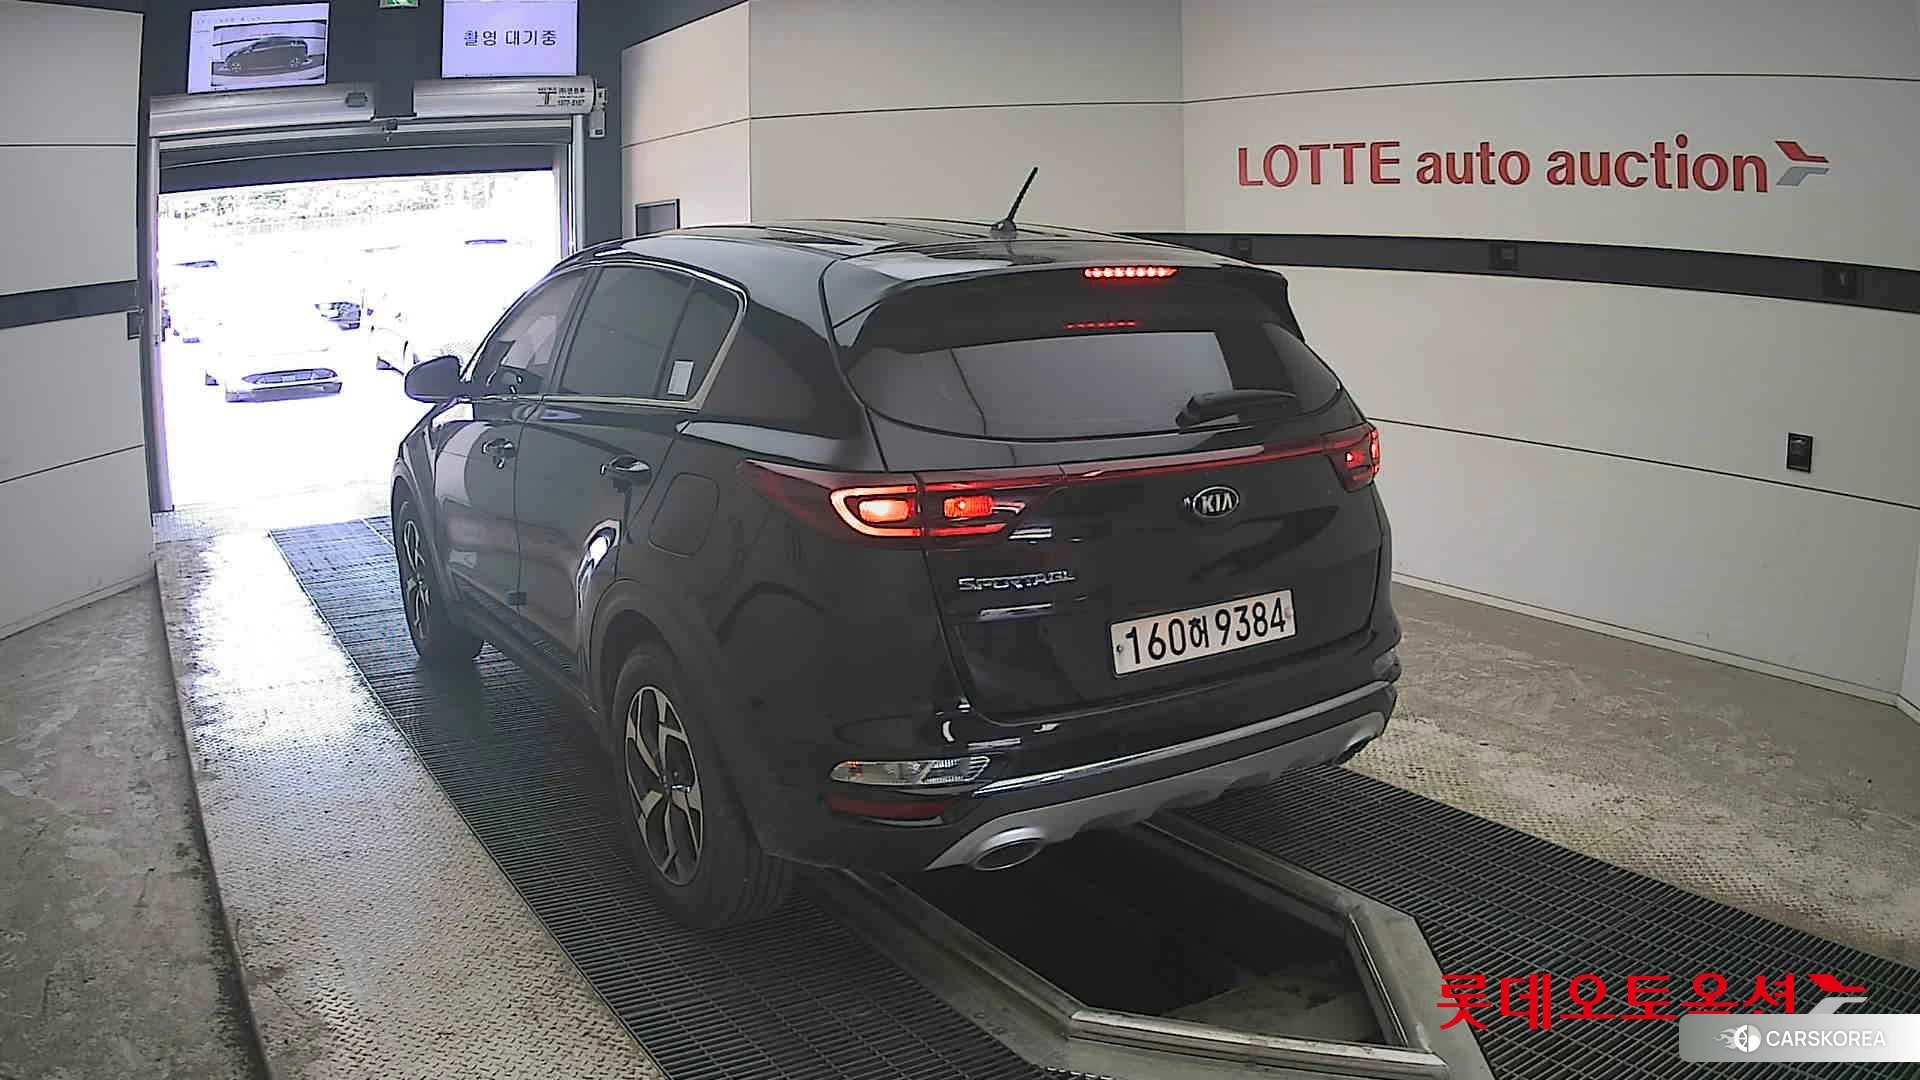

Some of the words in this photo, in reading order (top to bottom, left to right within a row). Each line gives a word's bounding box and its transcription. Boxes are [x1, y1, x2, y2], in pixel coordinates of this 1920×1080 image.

[463, 30, 497, 47] 촬영
[505, 30, 557, 47] 대기중
[1238, 141, 1400, 188] LOTTE
[1416, 142, 1530, 186] auto
[1546, 133, 1768, 193] auction
[1201, 492, 1232, 514] KIA
